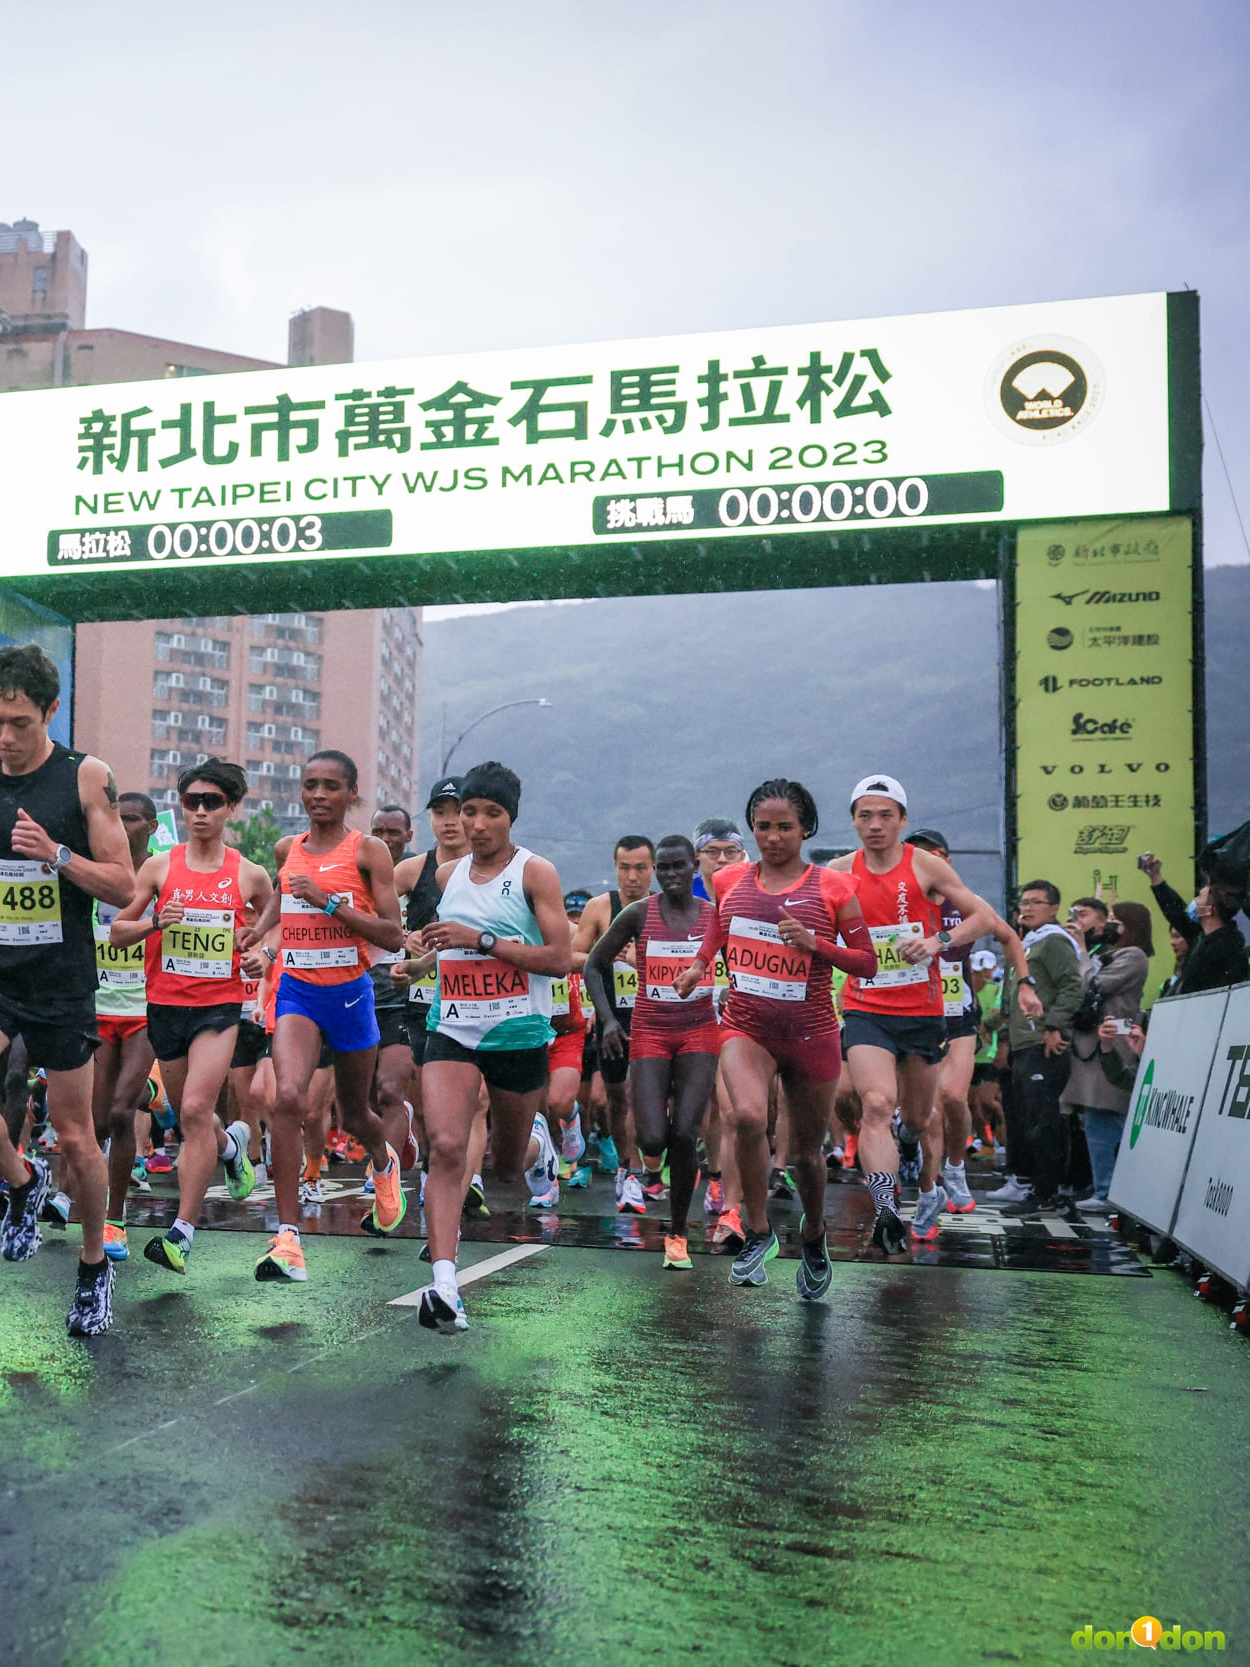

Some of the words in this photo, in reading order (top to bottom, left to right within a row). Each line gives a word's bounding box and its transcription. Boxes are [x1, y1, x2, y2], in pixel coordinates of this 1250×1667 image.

[76, 348, 894, 475] 新北市萬金石馬拉松
[75, 489, 160, 515] NEW
[172, 480, 292, 511] TAIPEI
[303, 472, 391, 502] CITY
[403, 465, 489, 495] WJS
[499, 448, 754, 489] MARATHON
[768, 440, 890, 472] 2023
[605, 494, 695, 530] 挑戰馬
[717, 477, 929, 528] 00:00:00
[57, 530, 132, 560] 馬拉松
[147, 515, 324, 561] 00:00:03
[1068, 676, 1163, 688] FOOTLAND
[1040, 762, 1170, 775] VOLVO
[169, 930, 225, 953] TENG
[166, 958, 176, 972] A
[286, 951, 296, 966] A
[728, 946, 807, 977] ADUGNA
[100, 970, 108, 982] A
[444, 969, 526, 997] MELEKA
[414, 987, 424, 1000] A
[651, 987, 661, 999] A
[619, 996, 628, 1006] A
[446, 1003, 459, 1019] A
